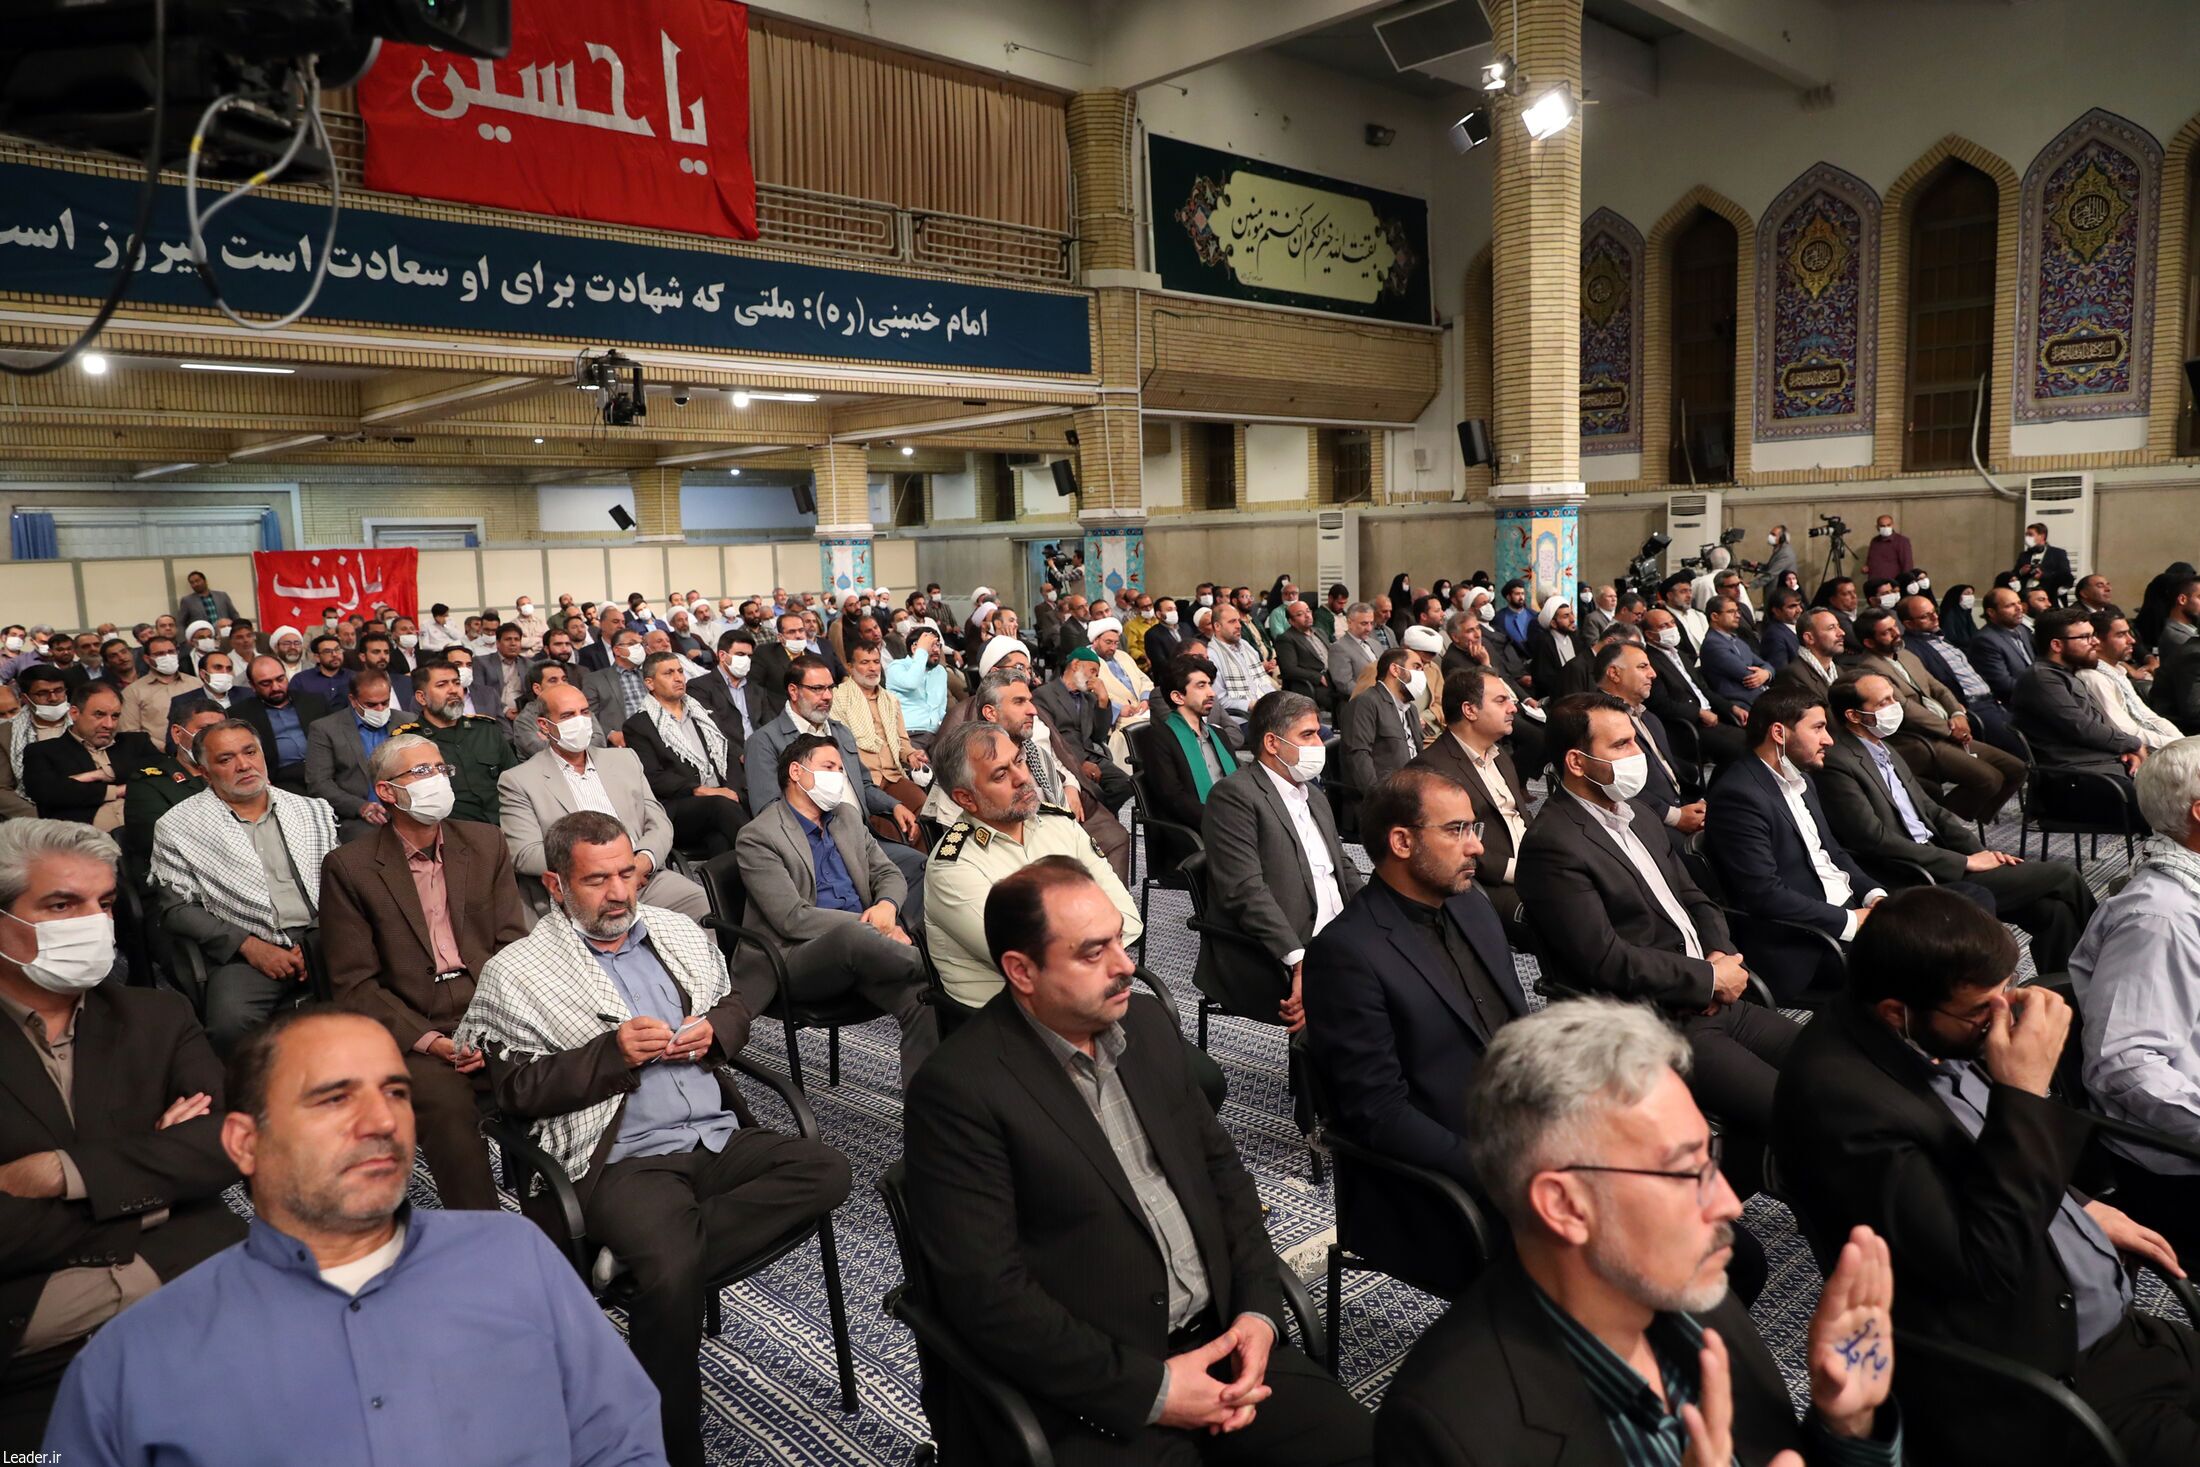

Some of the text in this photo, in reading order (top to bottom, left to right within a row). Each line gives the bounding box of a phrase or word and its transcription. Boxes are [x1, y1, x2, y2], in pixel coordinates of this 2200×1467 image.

[411, 28, 708, 176] یا حسین
[221, 234, 312, 272] است
[328, 244, 449, 287] سعادت
[460, 255, 489, 302] او
[501, 260, 576, 309] برای
[585, 271, 684, 315] شهادت
[692, 282, 725, 313] که
[734, 286, 795, 327] ملتی
[946, 306, 988, 342] امام
[272, 552, 389, 618] یا زینب
